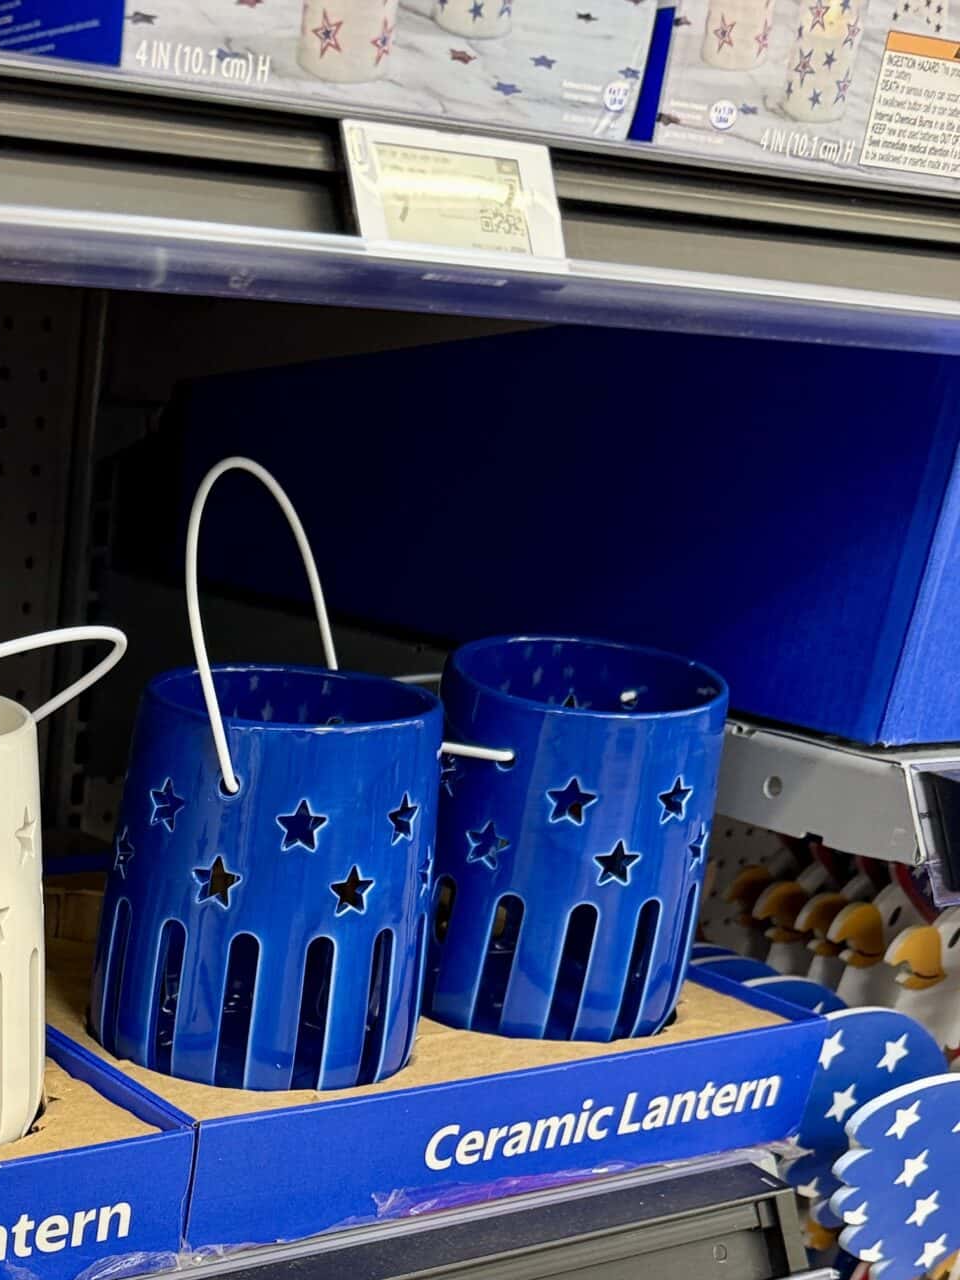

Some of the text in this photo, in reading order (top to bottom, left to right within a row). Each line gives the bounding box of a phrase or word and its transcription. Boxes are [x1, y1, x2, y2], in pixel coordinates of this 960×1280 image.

[135, 40, 270, 84] 4 IN (10.1 cm) H
[760, 128, 856, 162] 4 IN (10.1 cm) H
[424, 1074, 781, 1171] Ceramic Lantern
